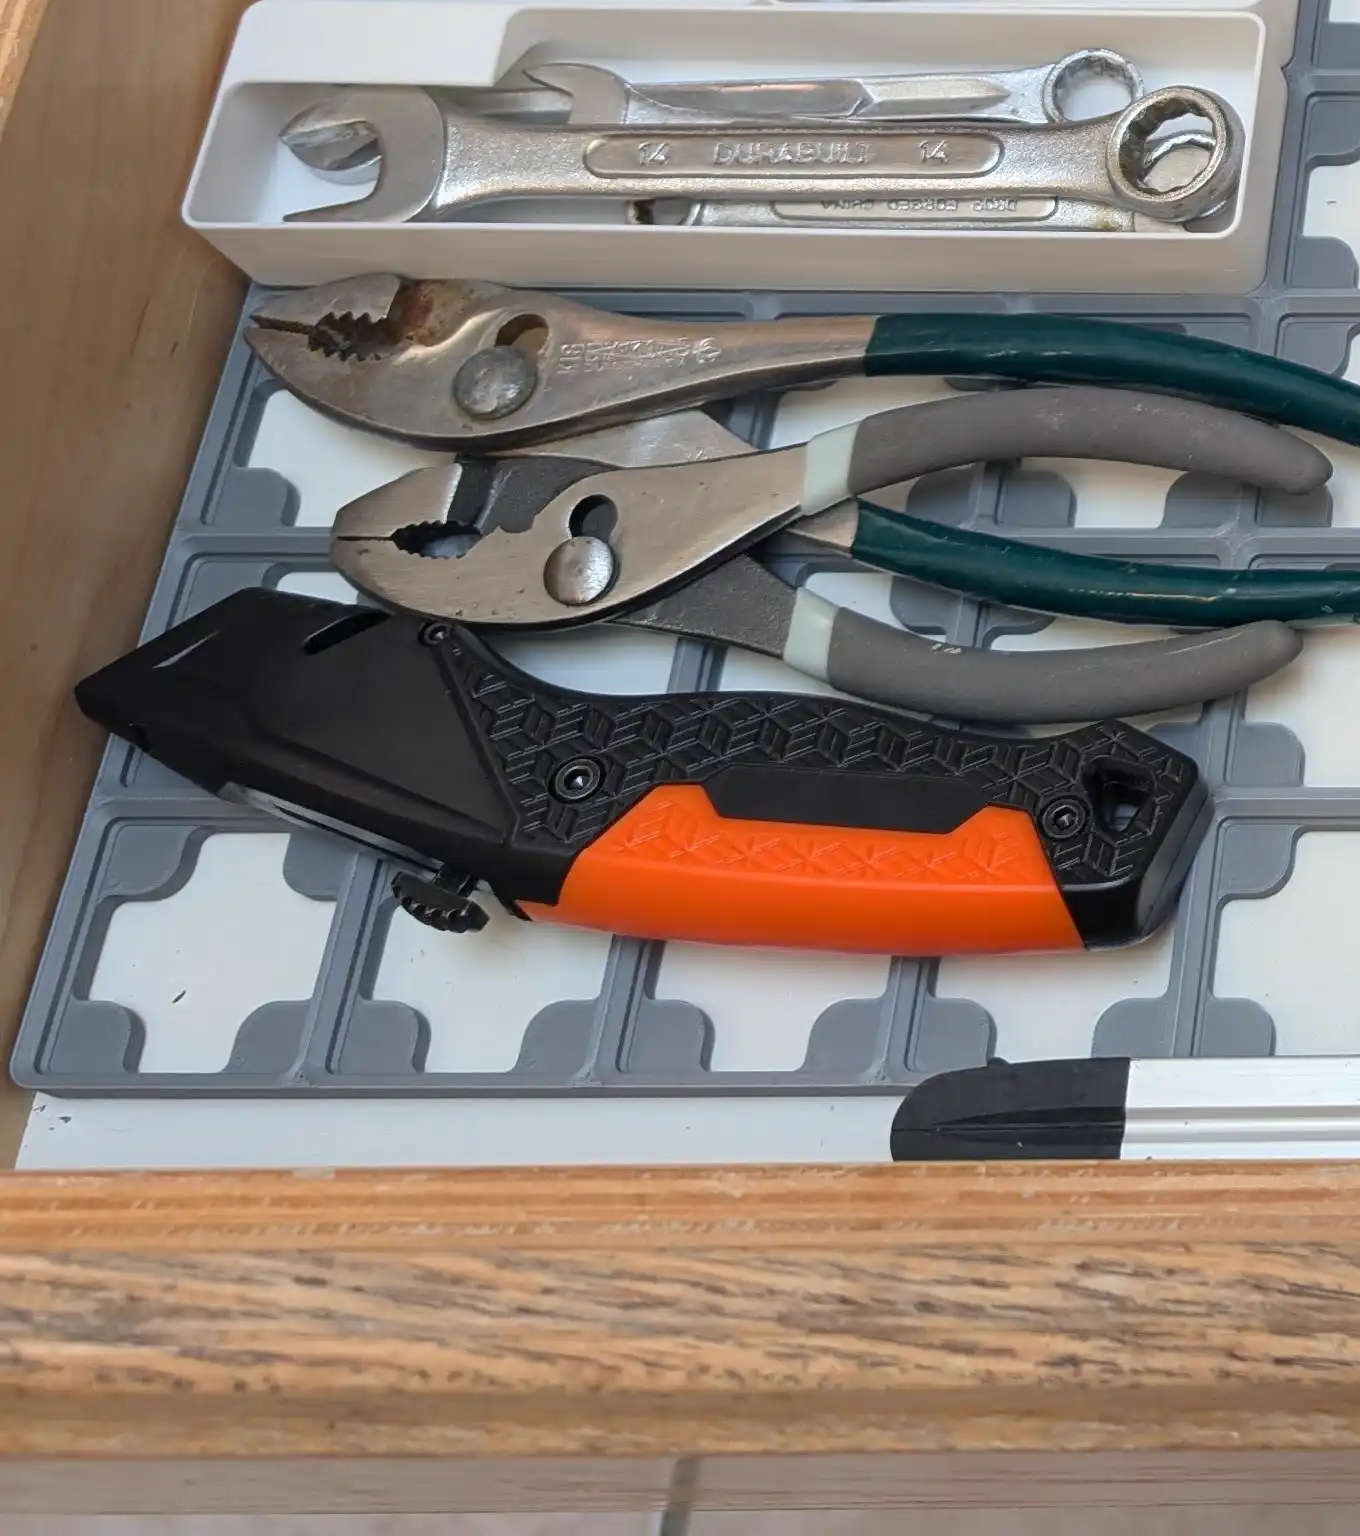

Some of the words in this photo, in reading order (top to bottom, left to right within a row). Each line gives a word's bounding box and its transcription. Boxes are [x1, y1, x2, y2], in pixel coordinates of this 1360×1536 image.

[636, 140, 672, 165] 14
[711, 141, 874, 165] DURABUILT
[917, 139, 951, 163] 14
